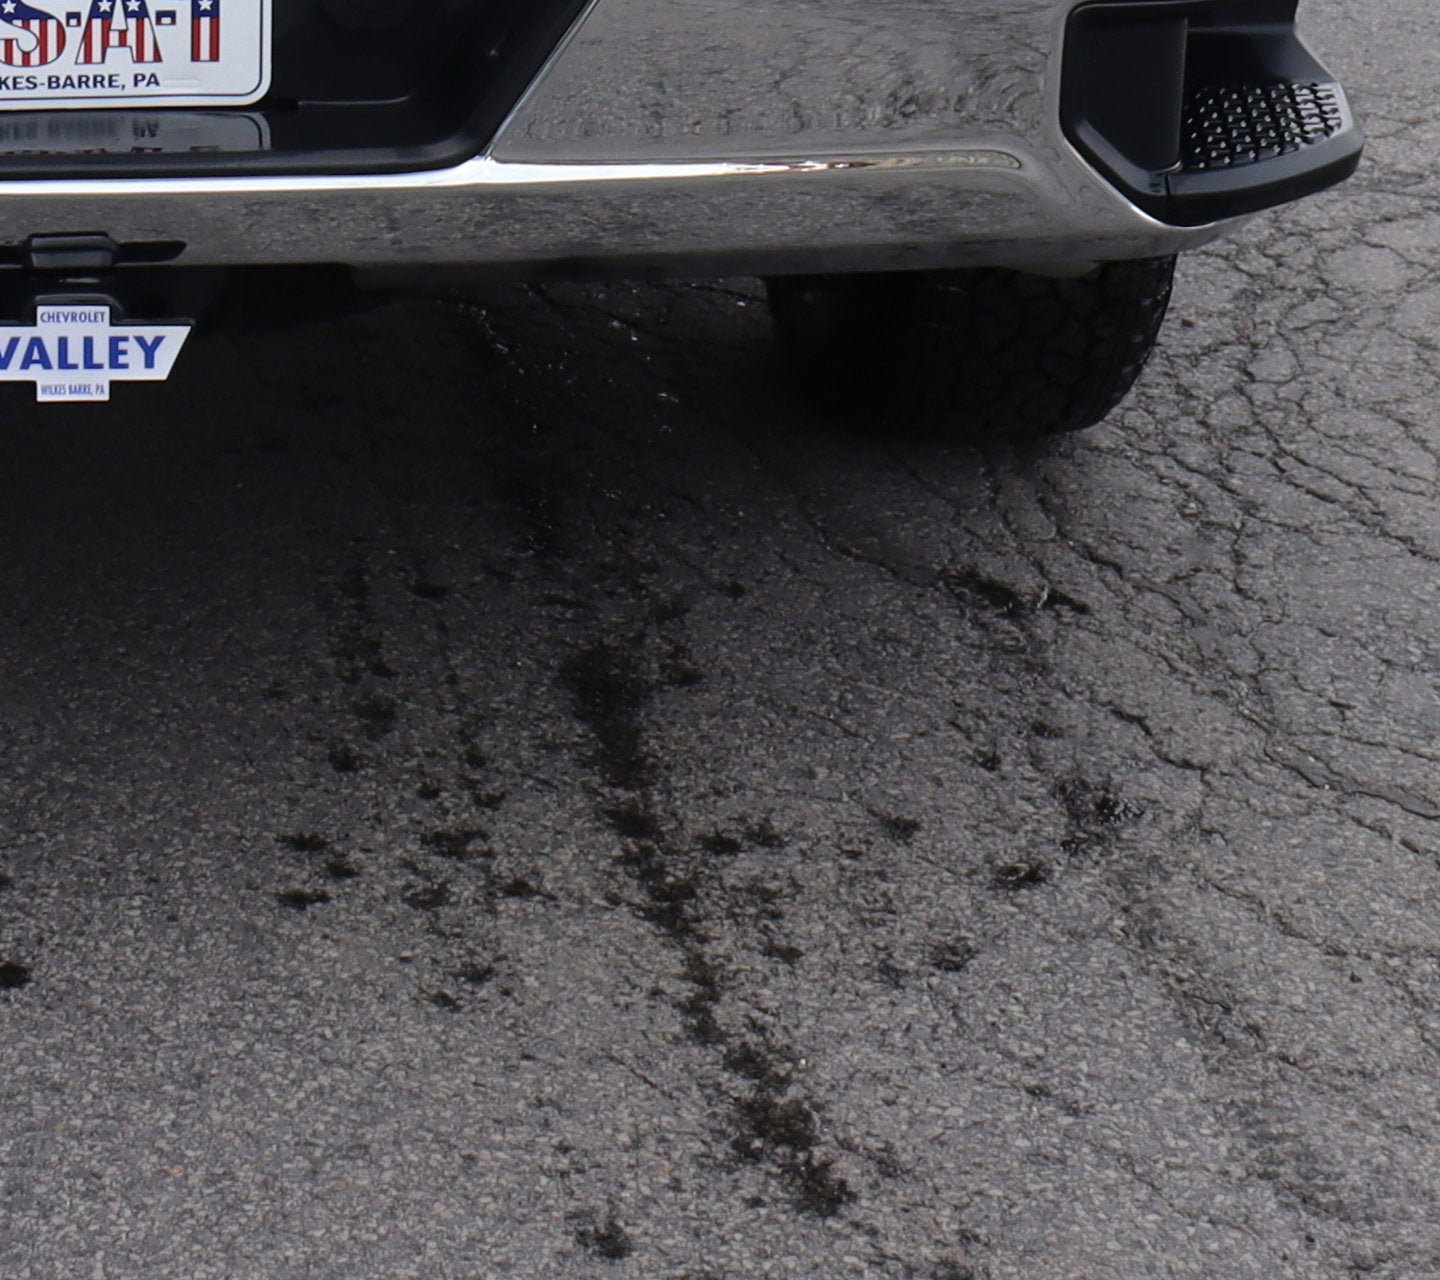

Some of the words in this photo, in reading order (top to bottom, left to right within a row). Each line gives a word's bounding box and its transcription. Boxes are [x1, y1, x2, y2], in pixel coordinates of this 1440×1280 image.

[133, 72, 162, 89] PA
[40, 311, 106, 324] CHEVROLET
[40, 385, 67, 396] WILKES
[68, 384, 94, 397] BARRE,
[95, 384, 106, 395] PA
